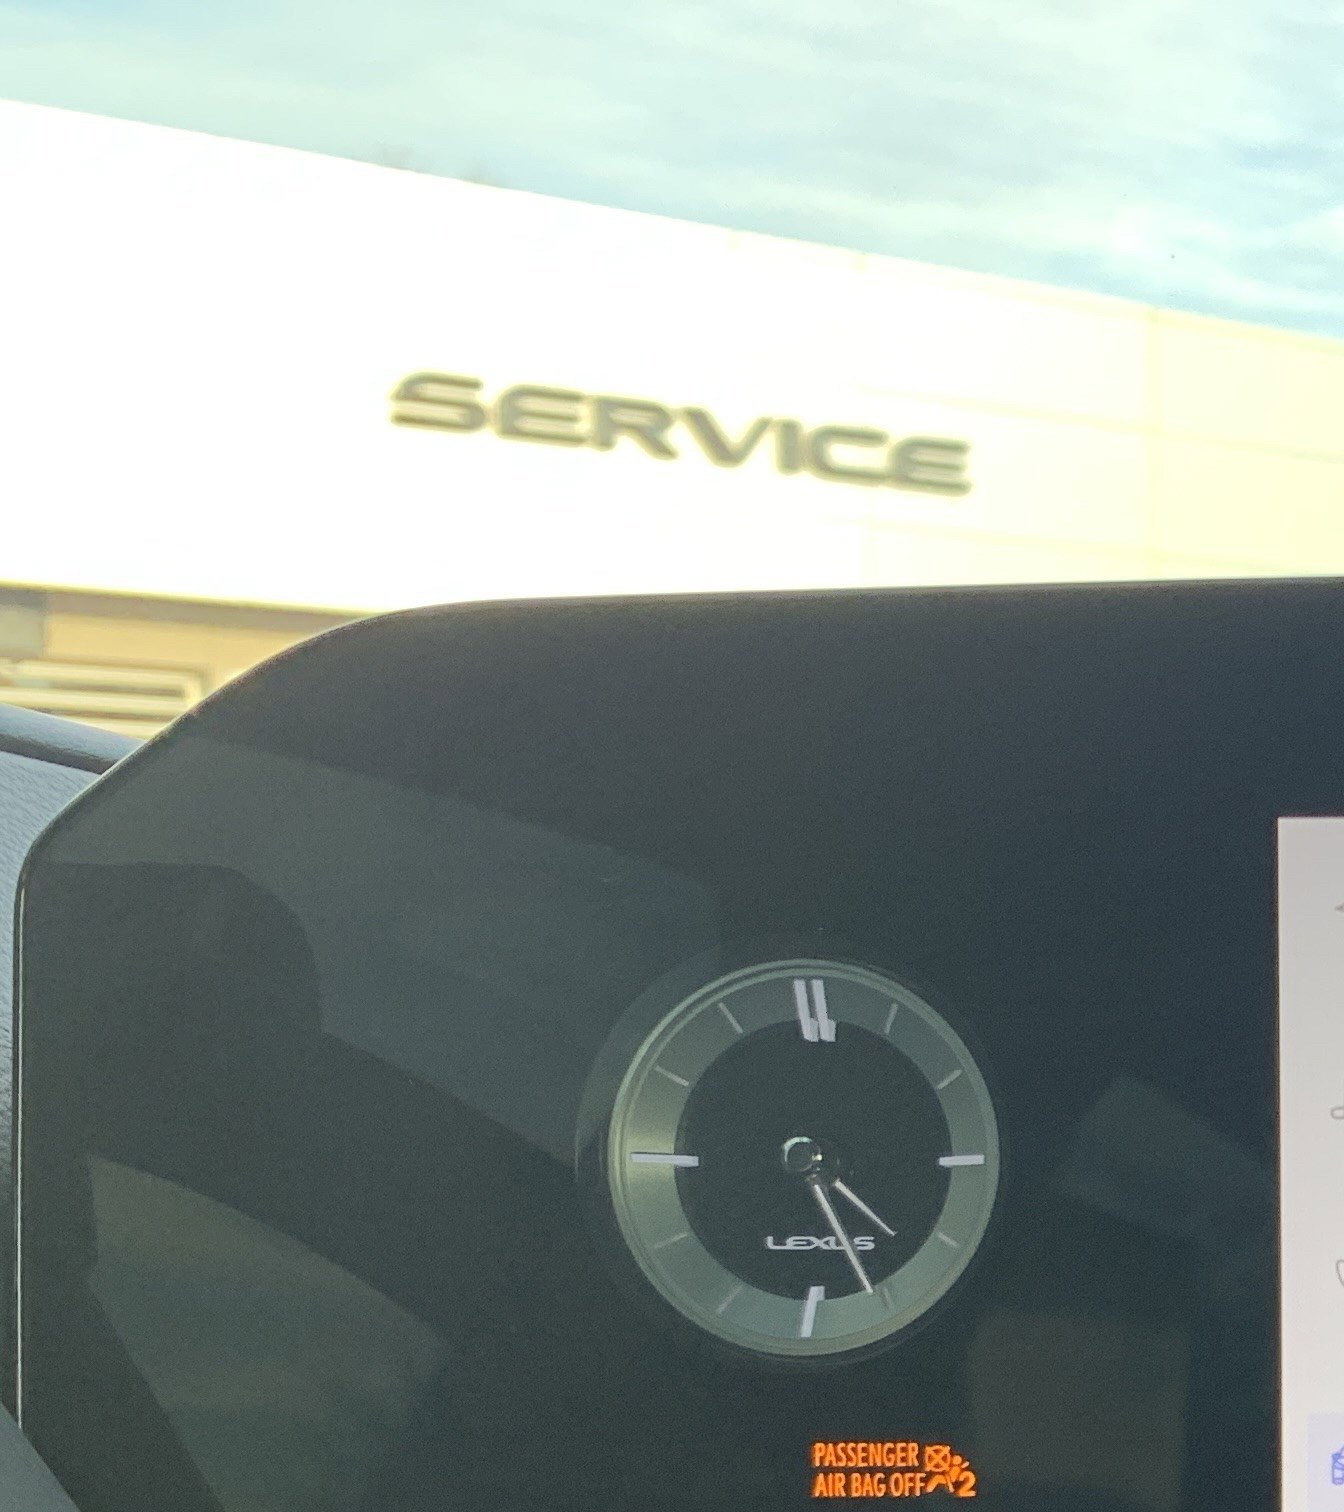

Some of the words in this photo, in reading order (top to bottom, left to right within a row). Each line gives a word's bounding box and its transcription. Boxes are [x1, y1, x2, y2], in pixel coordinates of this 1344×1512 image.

[391, 372, 971, 496] SERVICE
[766, 1235, 875, 1250] LEXUS
[813, 1442, 919, 1467] PASSENGER
[814, 1472, 847, 1497] AIR
[850, 1472, 887, 1497] BAG
[890, 1472, 926, 1497] OFF
